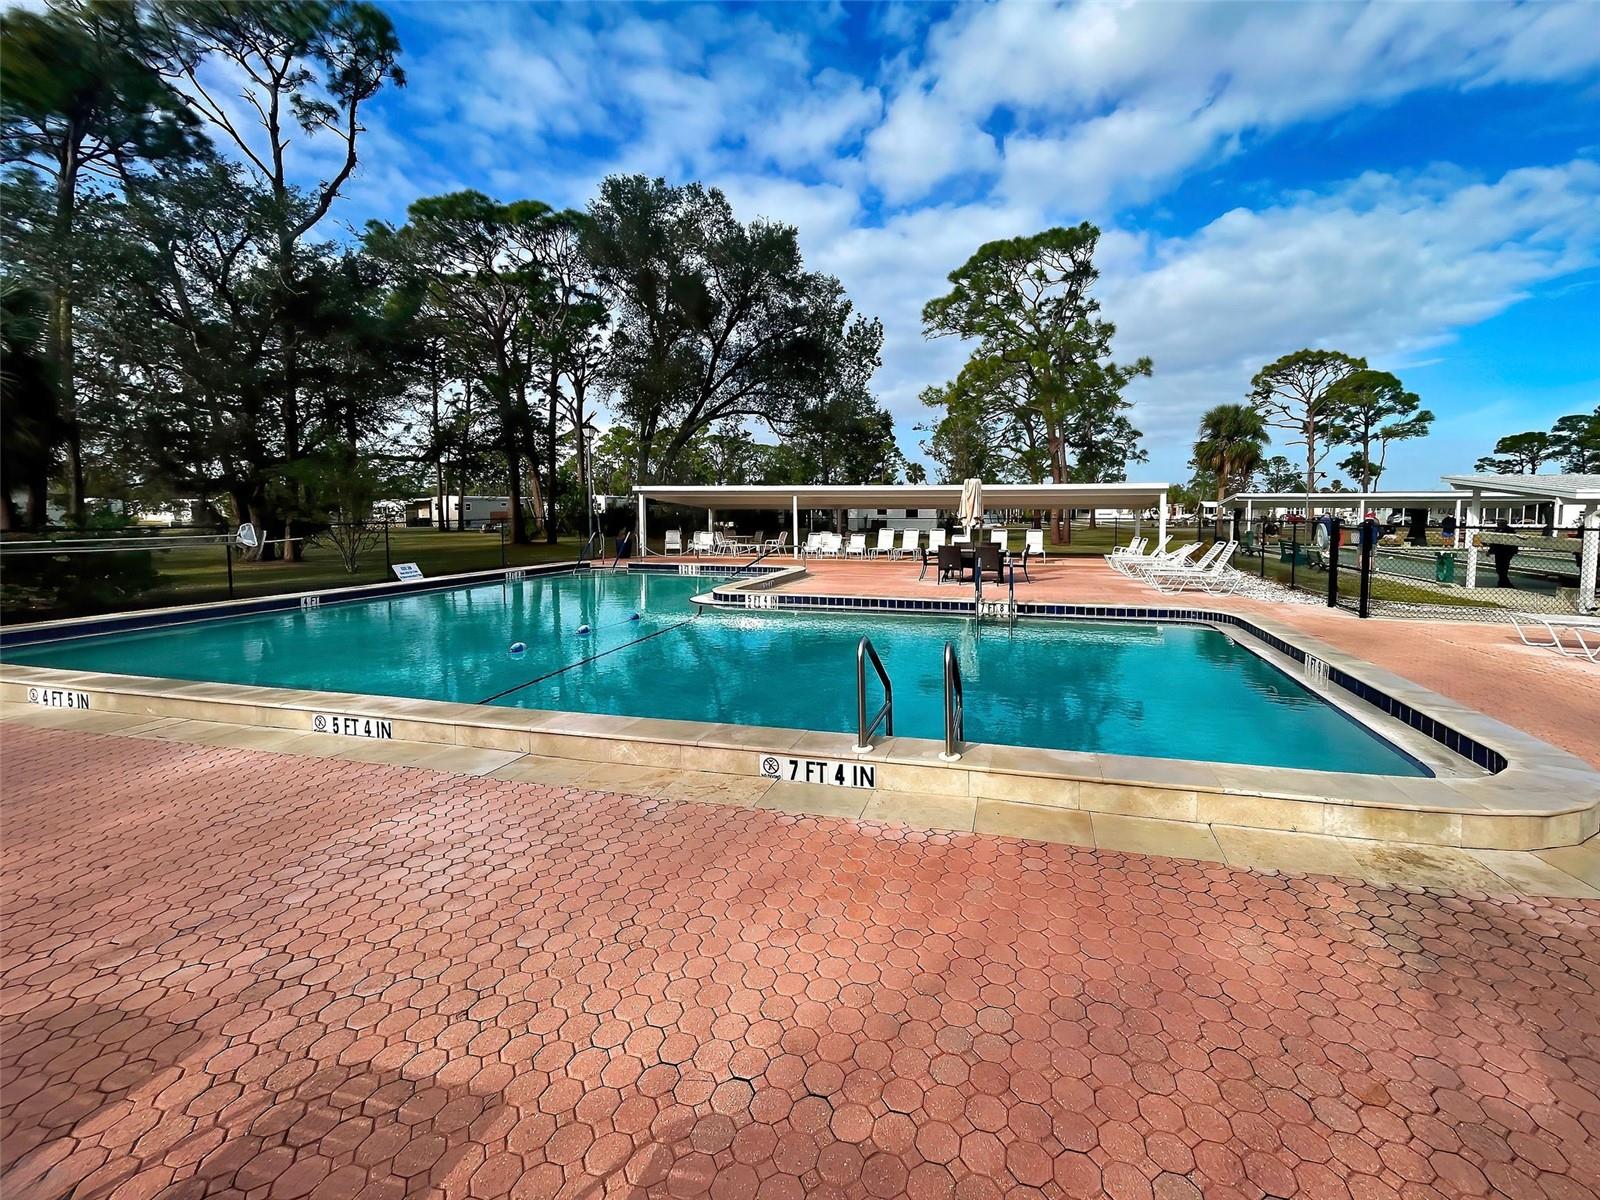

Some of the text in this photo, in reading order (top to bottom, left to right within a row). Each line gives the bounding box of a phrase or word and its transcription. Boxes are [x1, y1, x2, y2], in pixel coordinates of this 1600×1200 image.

[43, 690, 89, 710] 4 FT 5 IN
[332, 717, 392, 739] 5 FT 4 IN
[789, 759, 875, 788] 7 FT 4 IN
